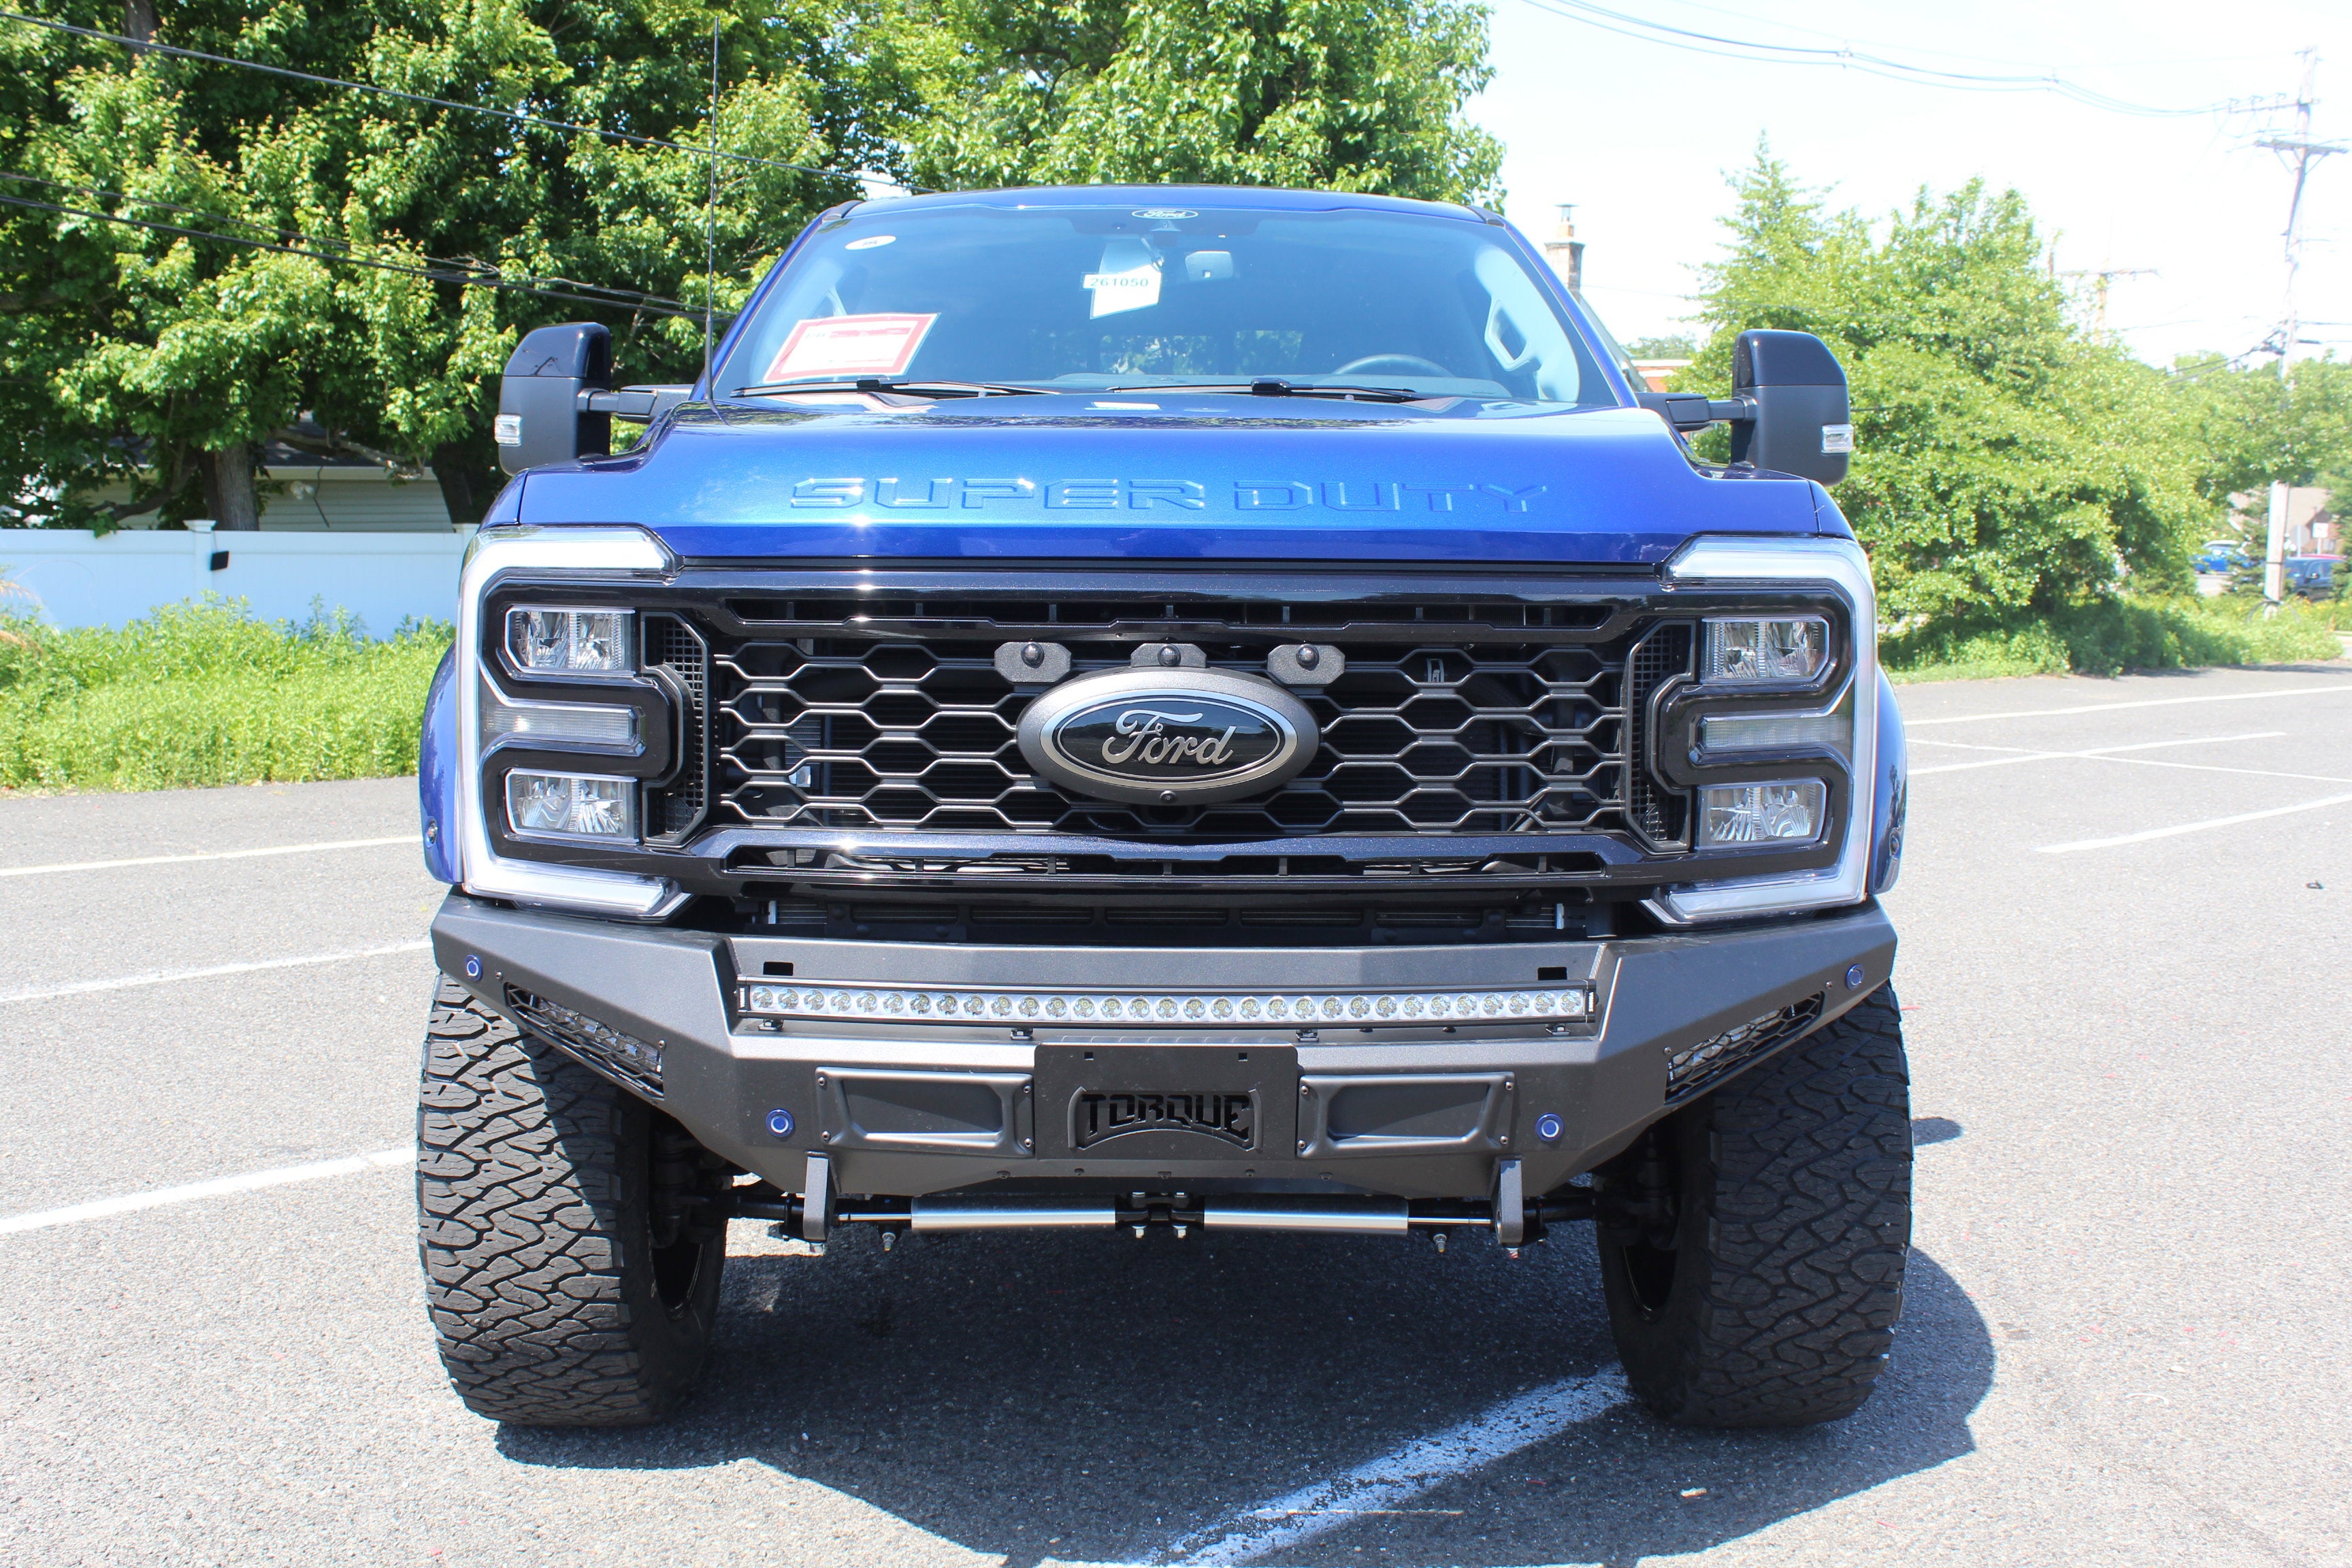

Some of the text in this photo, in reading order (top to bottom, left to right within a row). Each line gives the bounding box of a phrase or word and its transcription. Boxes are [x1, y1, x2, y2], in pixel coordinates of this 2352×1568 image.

[1143, 210, 1186, 218] Ford
[1090, 278, 1149, 288] 261050
[791, 478, 1548, 512] SUPER DUTY
[1101, 709, 1237, 765] Ford
[1081, 1094, 1251, 1142] TORQUE
